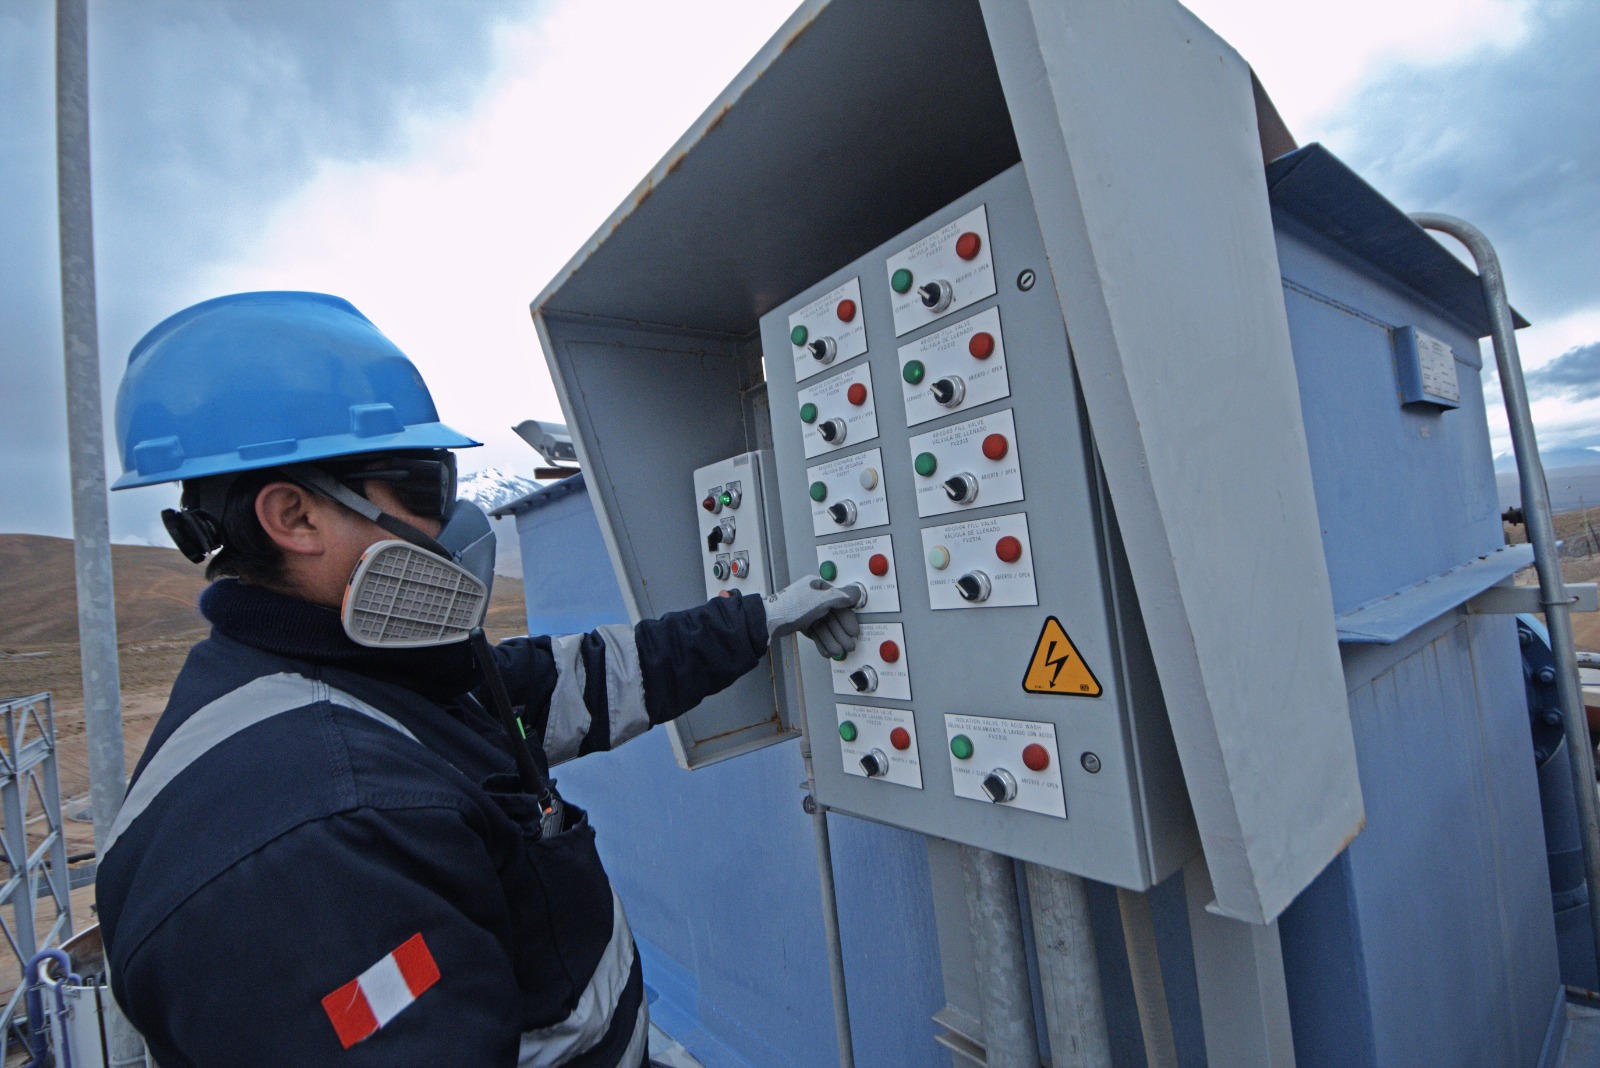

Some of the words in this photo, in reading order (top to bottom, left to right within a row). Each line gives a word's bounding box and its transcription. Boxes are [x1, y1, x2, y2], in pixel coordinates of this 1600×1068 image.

[955, 320, 971, 331] VALVE
[950, 326, 974, 340] LLENADO
[954, 424, 965, 432] FILL
[968, 419, 985, 429] VALVE
[963, 426, 987, 437] LLENADO
[976, 526, 1001, 535] LLENADO
